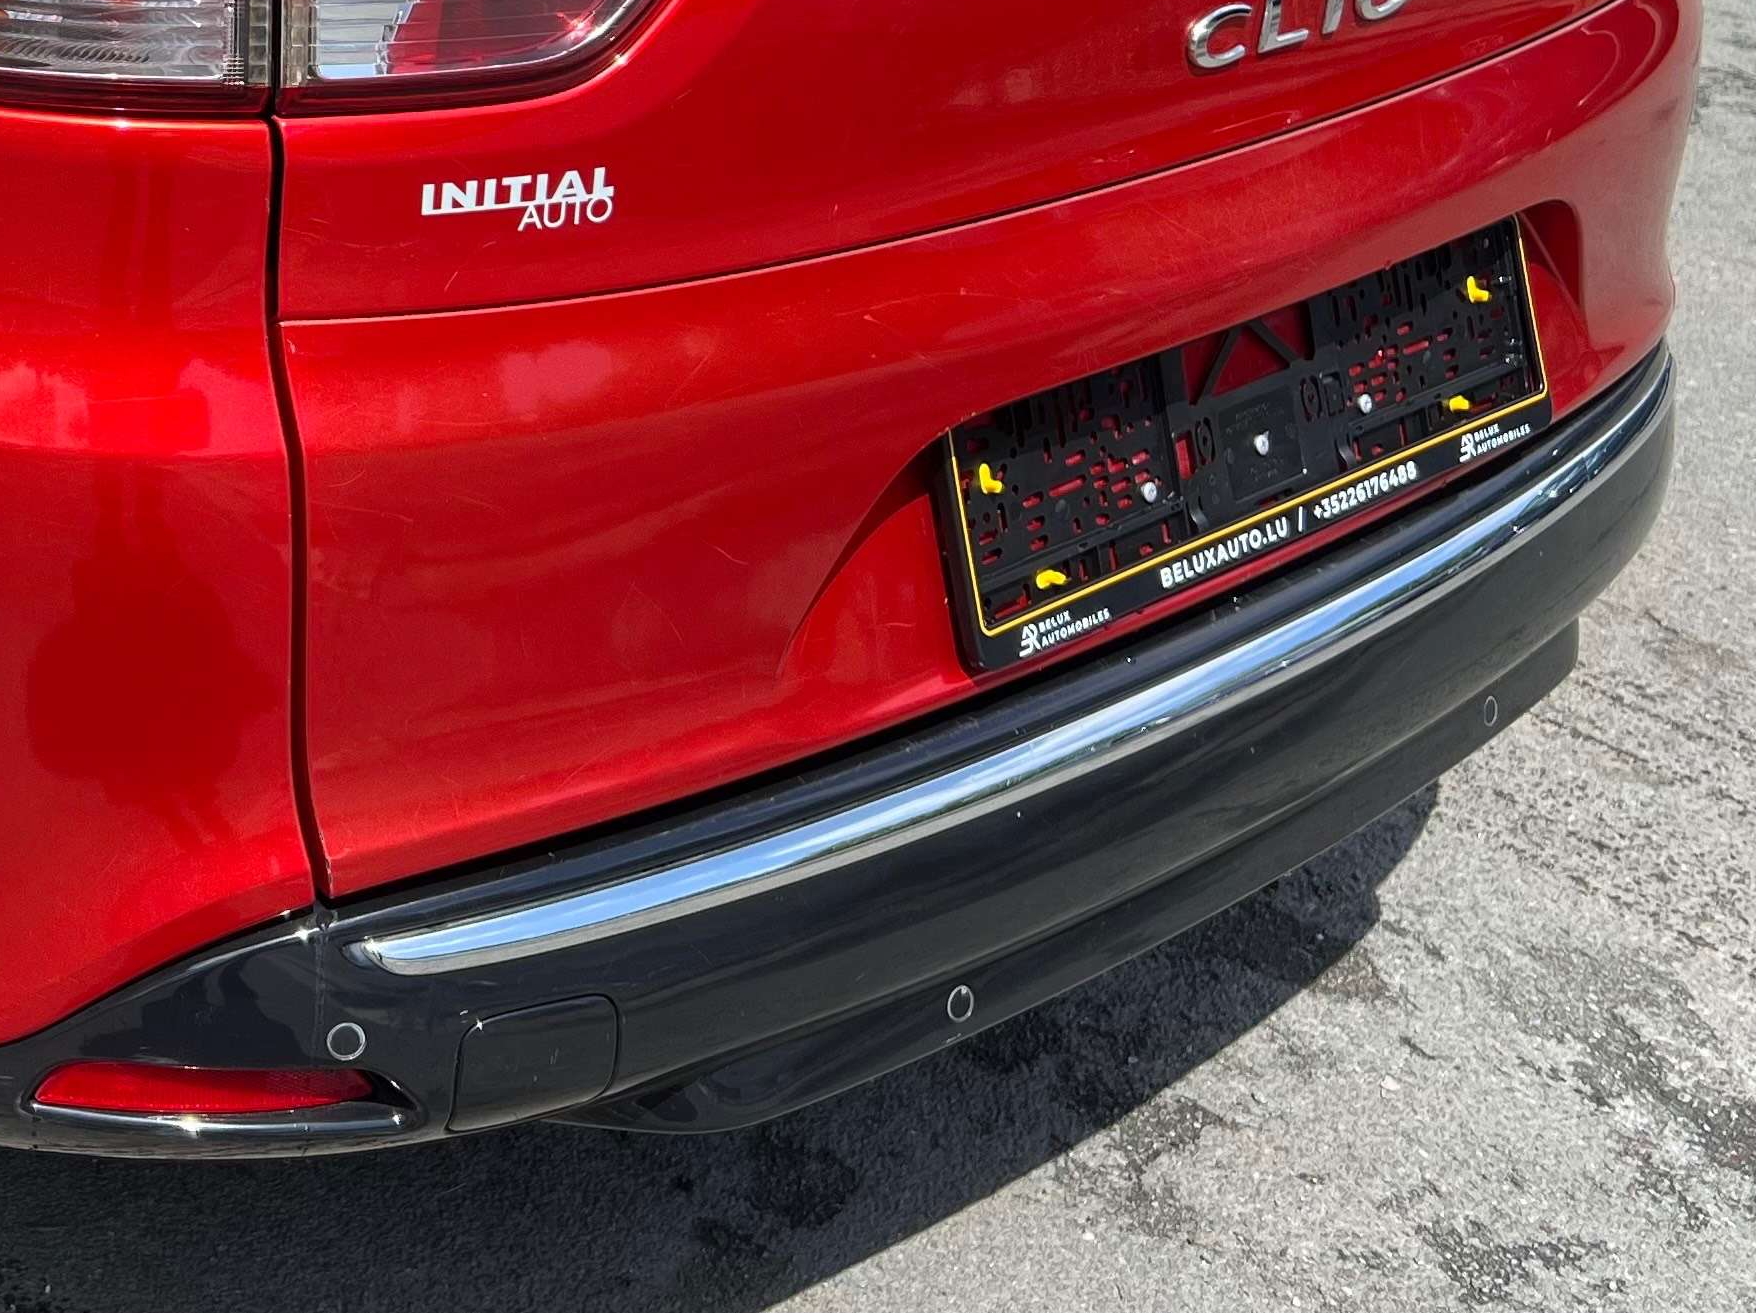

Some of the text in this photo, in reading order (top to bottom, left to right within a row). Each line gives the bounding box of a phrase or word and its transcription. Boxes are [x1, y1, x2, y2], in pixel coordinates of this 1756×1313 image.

[421, 166, 614, 216] INITIAL
[517, 196, 613, 231] AUTO
[1473, 423, 1500, 443] BELUX
[1477, 423, 1531, 454] AUTOMOBILES
[1160, 516, 1289, 589] BELUXAUTO.LU
[1313, 460, 1418, 520] +35226176488
[1038, 610, 1071, 633] BELUX
[1042, 608, 1110, 647] AUTOMOBILES
